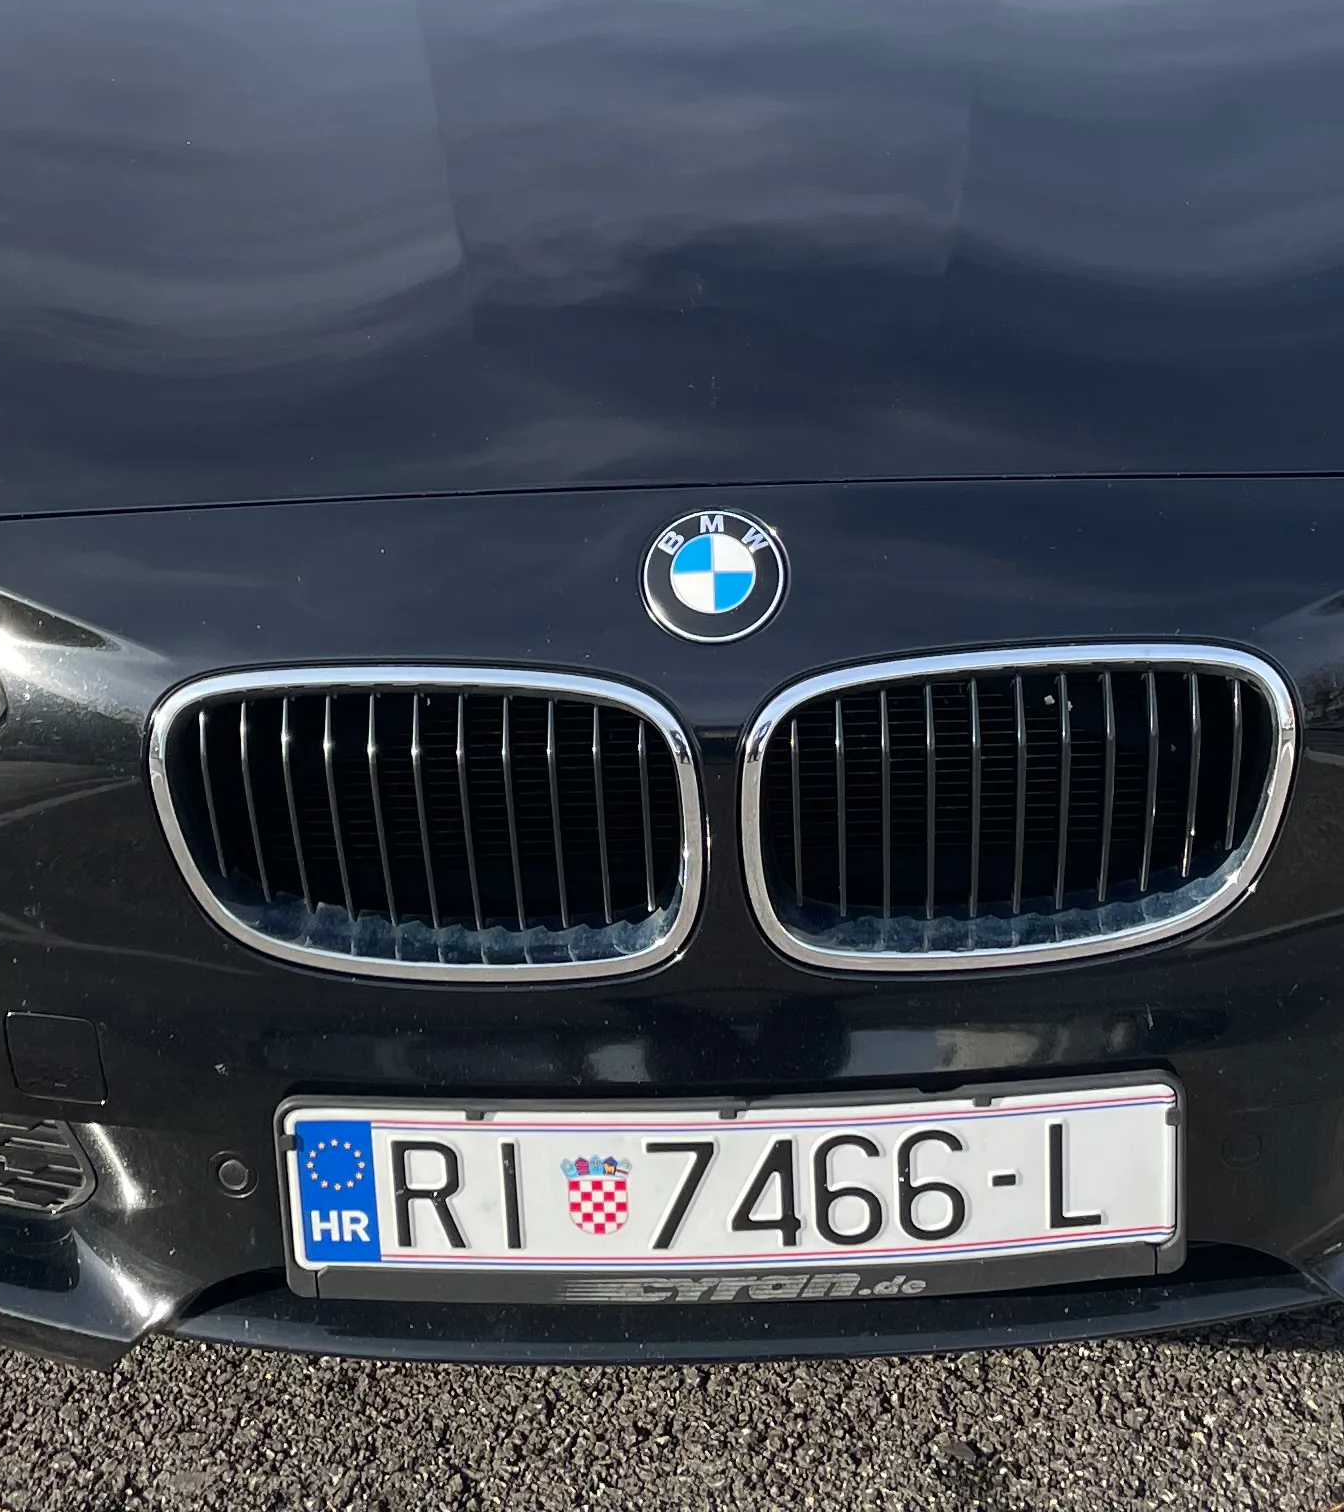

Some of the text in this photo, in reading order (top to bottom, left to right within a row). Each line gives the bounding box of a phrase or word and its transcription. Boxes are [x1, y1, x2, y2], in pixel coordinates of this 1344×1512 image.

[657, 514, 769, 556] BMW
[390, 1120, 1105, 1251] RI 7466-L
[310, 1209, 372, 1243] HR
